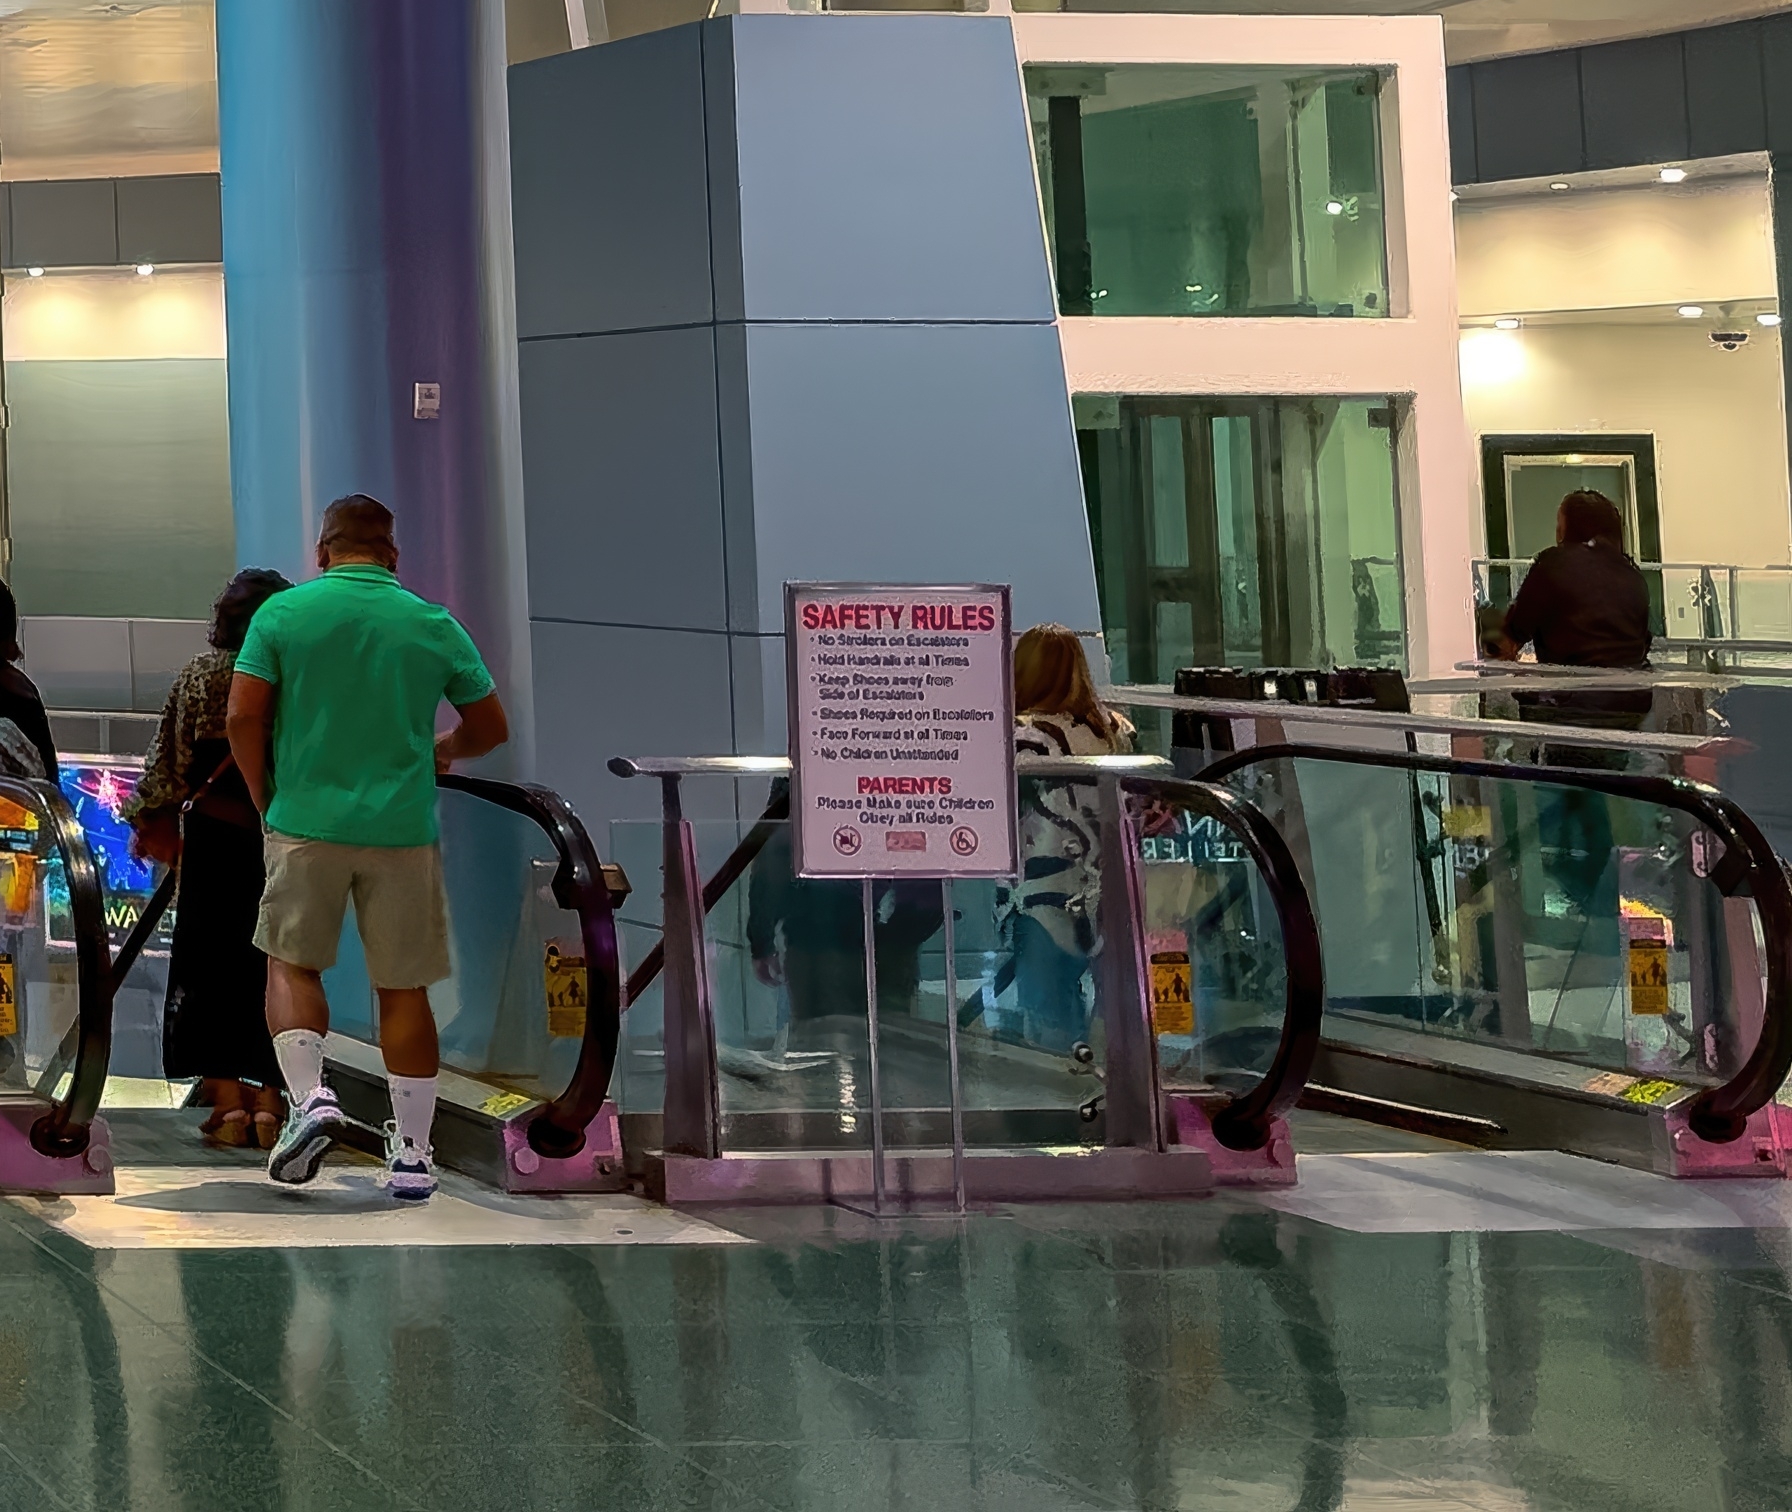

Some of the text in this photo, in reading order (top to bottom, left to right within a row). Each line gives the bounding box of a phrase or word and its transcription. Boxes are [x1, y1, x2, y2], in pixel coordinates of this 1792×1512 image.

[802, 603, 996, 631] SAFETY RULES
[818, 634, 835, 646] No
[818, 654, 846, 666] Hold
[820, 727, 848, 740] Face
[851, 728, 901, 740] Forward
[820, 747, 837, 760] No
[857, 776, 953, 794] PARENTS
[817, 796, 863, 810] Please
